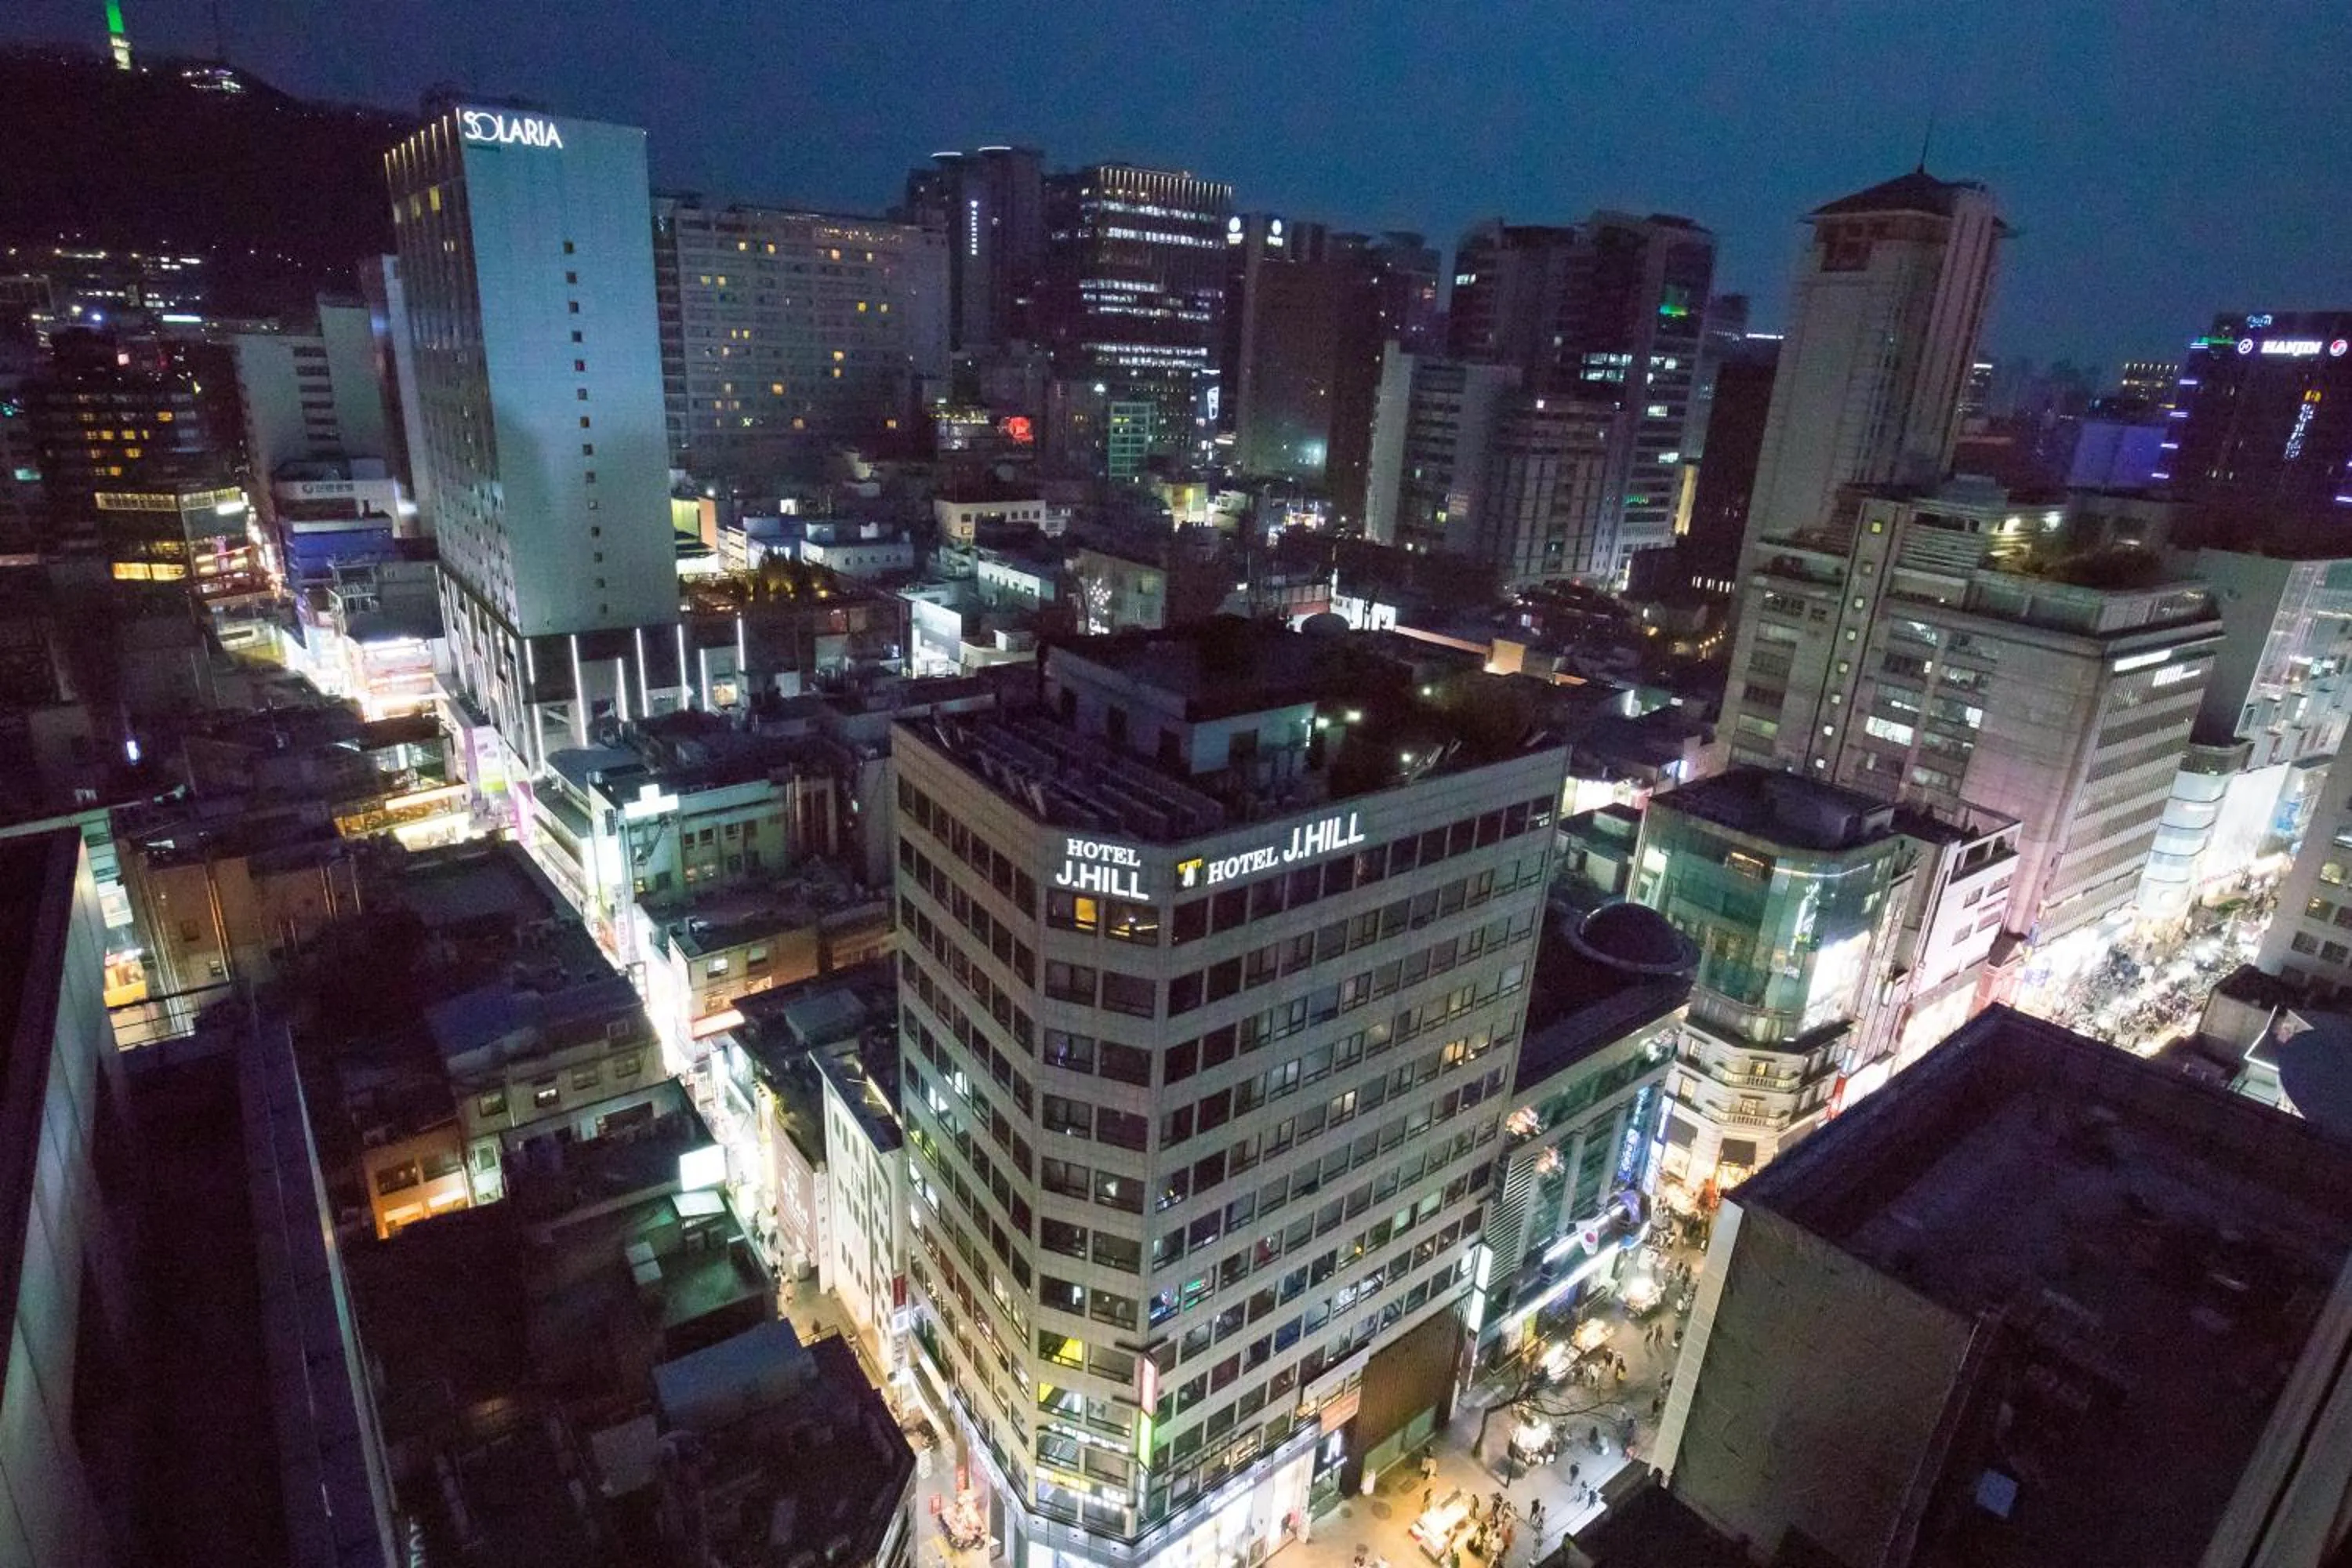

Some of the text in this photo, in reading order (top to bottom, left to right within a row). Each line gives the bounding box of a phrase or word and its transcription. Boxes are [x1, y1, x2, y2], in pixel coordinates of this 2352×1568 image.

[463, 111, 564, 149] SOLARIA
[2261, 340, 2323, 357] HANJIN
[1066, 838, 1142, 867] HOTEL
[1207, 812, 1366, 885] HOTEL J.HILL
[1055, 860, 1150, 901] J.HILL
